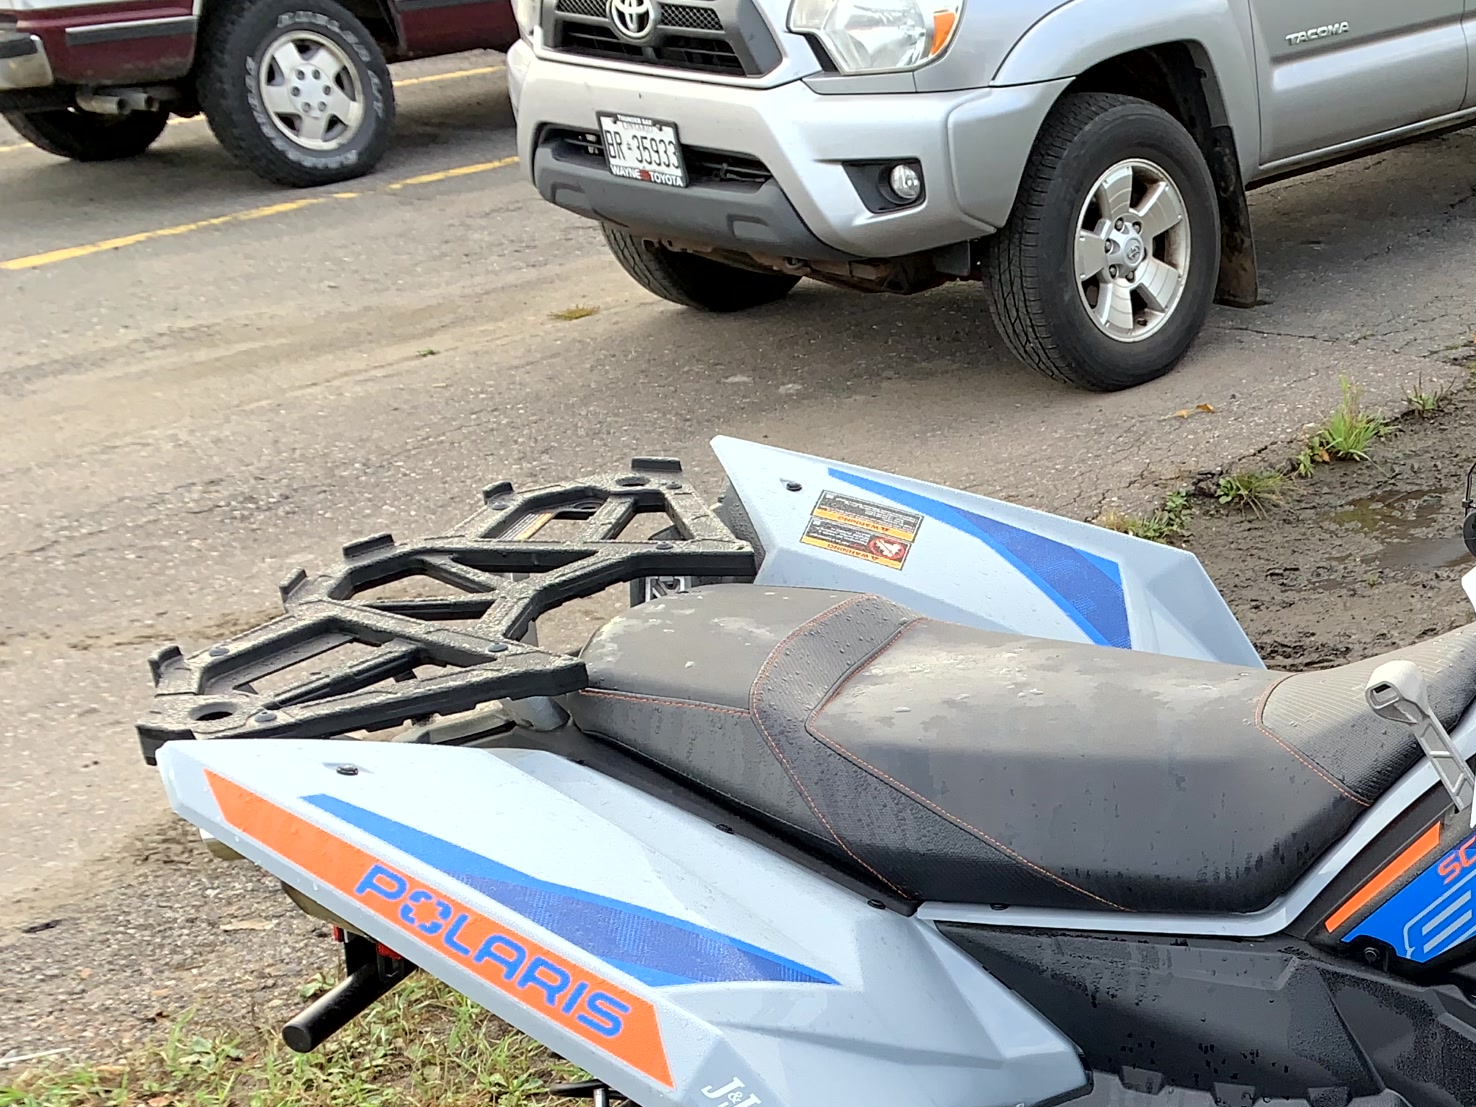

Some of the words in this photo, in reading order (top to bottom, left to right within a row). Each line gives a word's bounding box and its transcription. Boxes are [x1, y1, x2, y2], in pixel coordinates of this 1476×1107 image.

[1286, 21, 1349, 46] TACOMA
[610, 165, 641, 179] WAYNE
[649, 171, 683, 187] TOYOTA
[354, 864, 631, 1039] POLARIS
